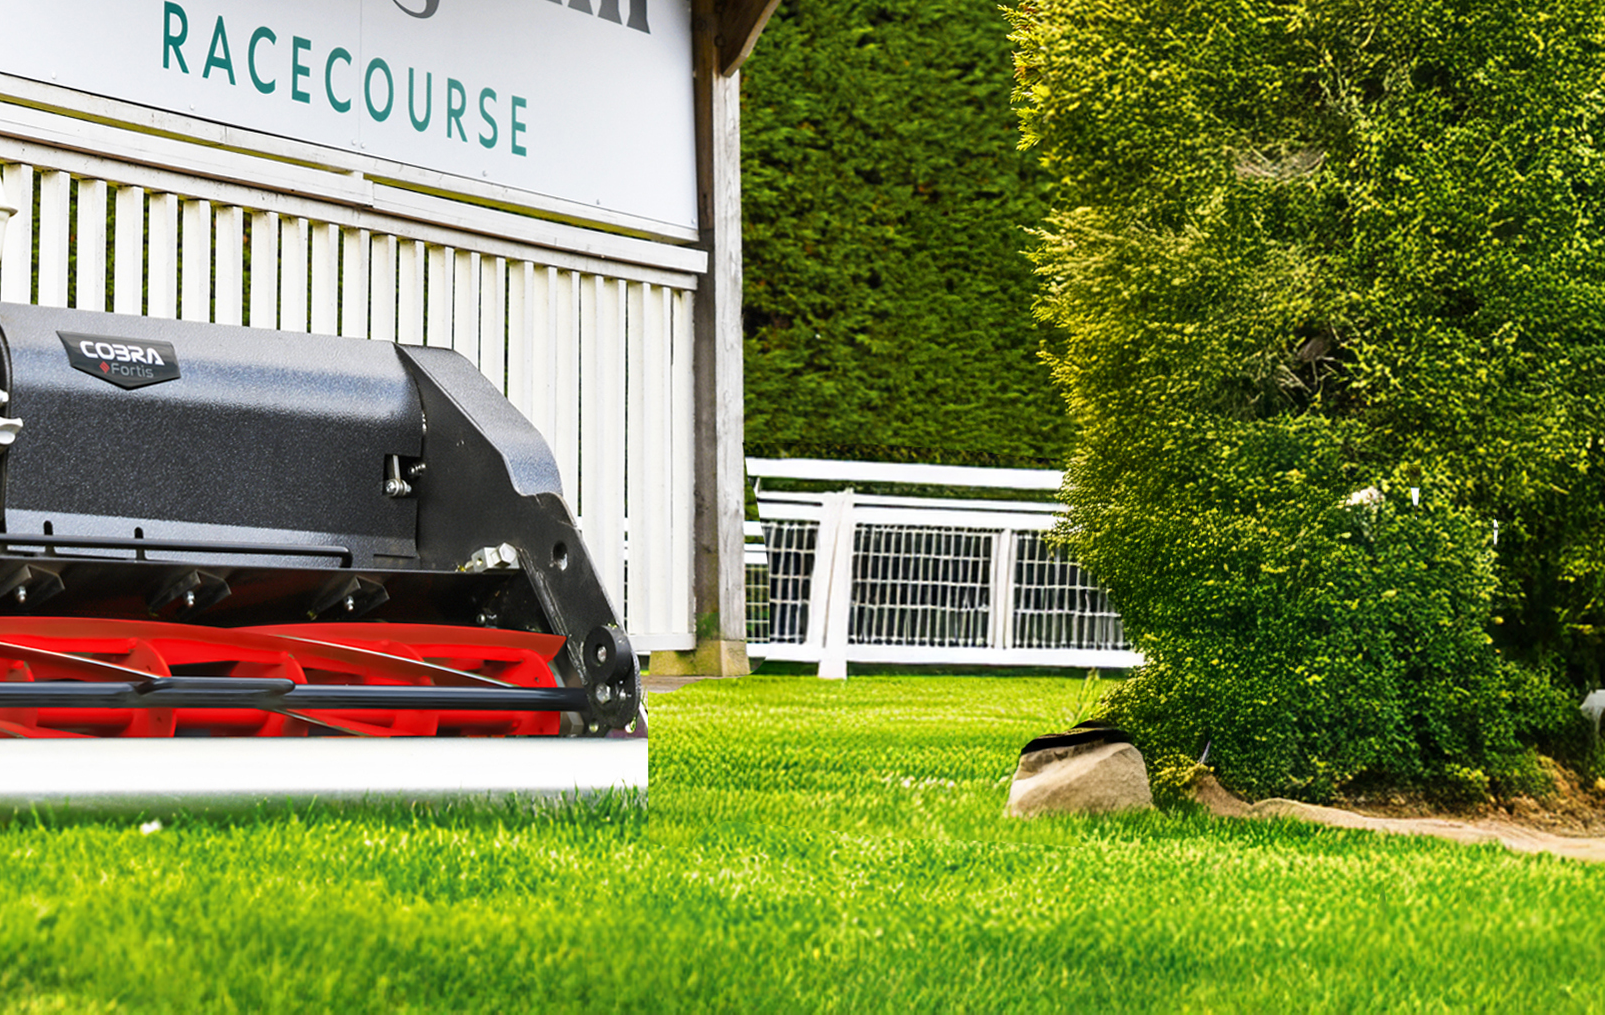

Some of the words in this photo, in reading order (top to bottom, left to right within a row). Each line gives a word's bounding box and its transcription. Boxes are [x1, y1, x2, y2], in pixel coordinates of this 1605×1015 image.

[162, 0, 528, 158] RACECOURSE
[79, 340, 165, 366] COBRA
[111, 362, 154, 379] Fortis
